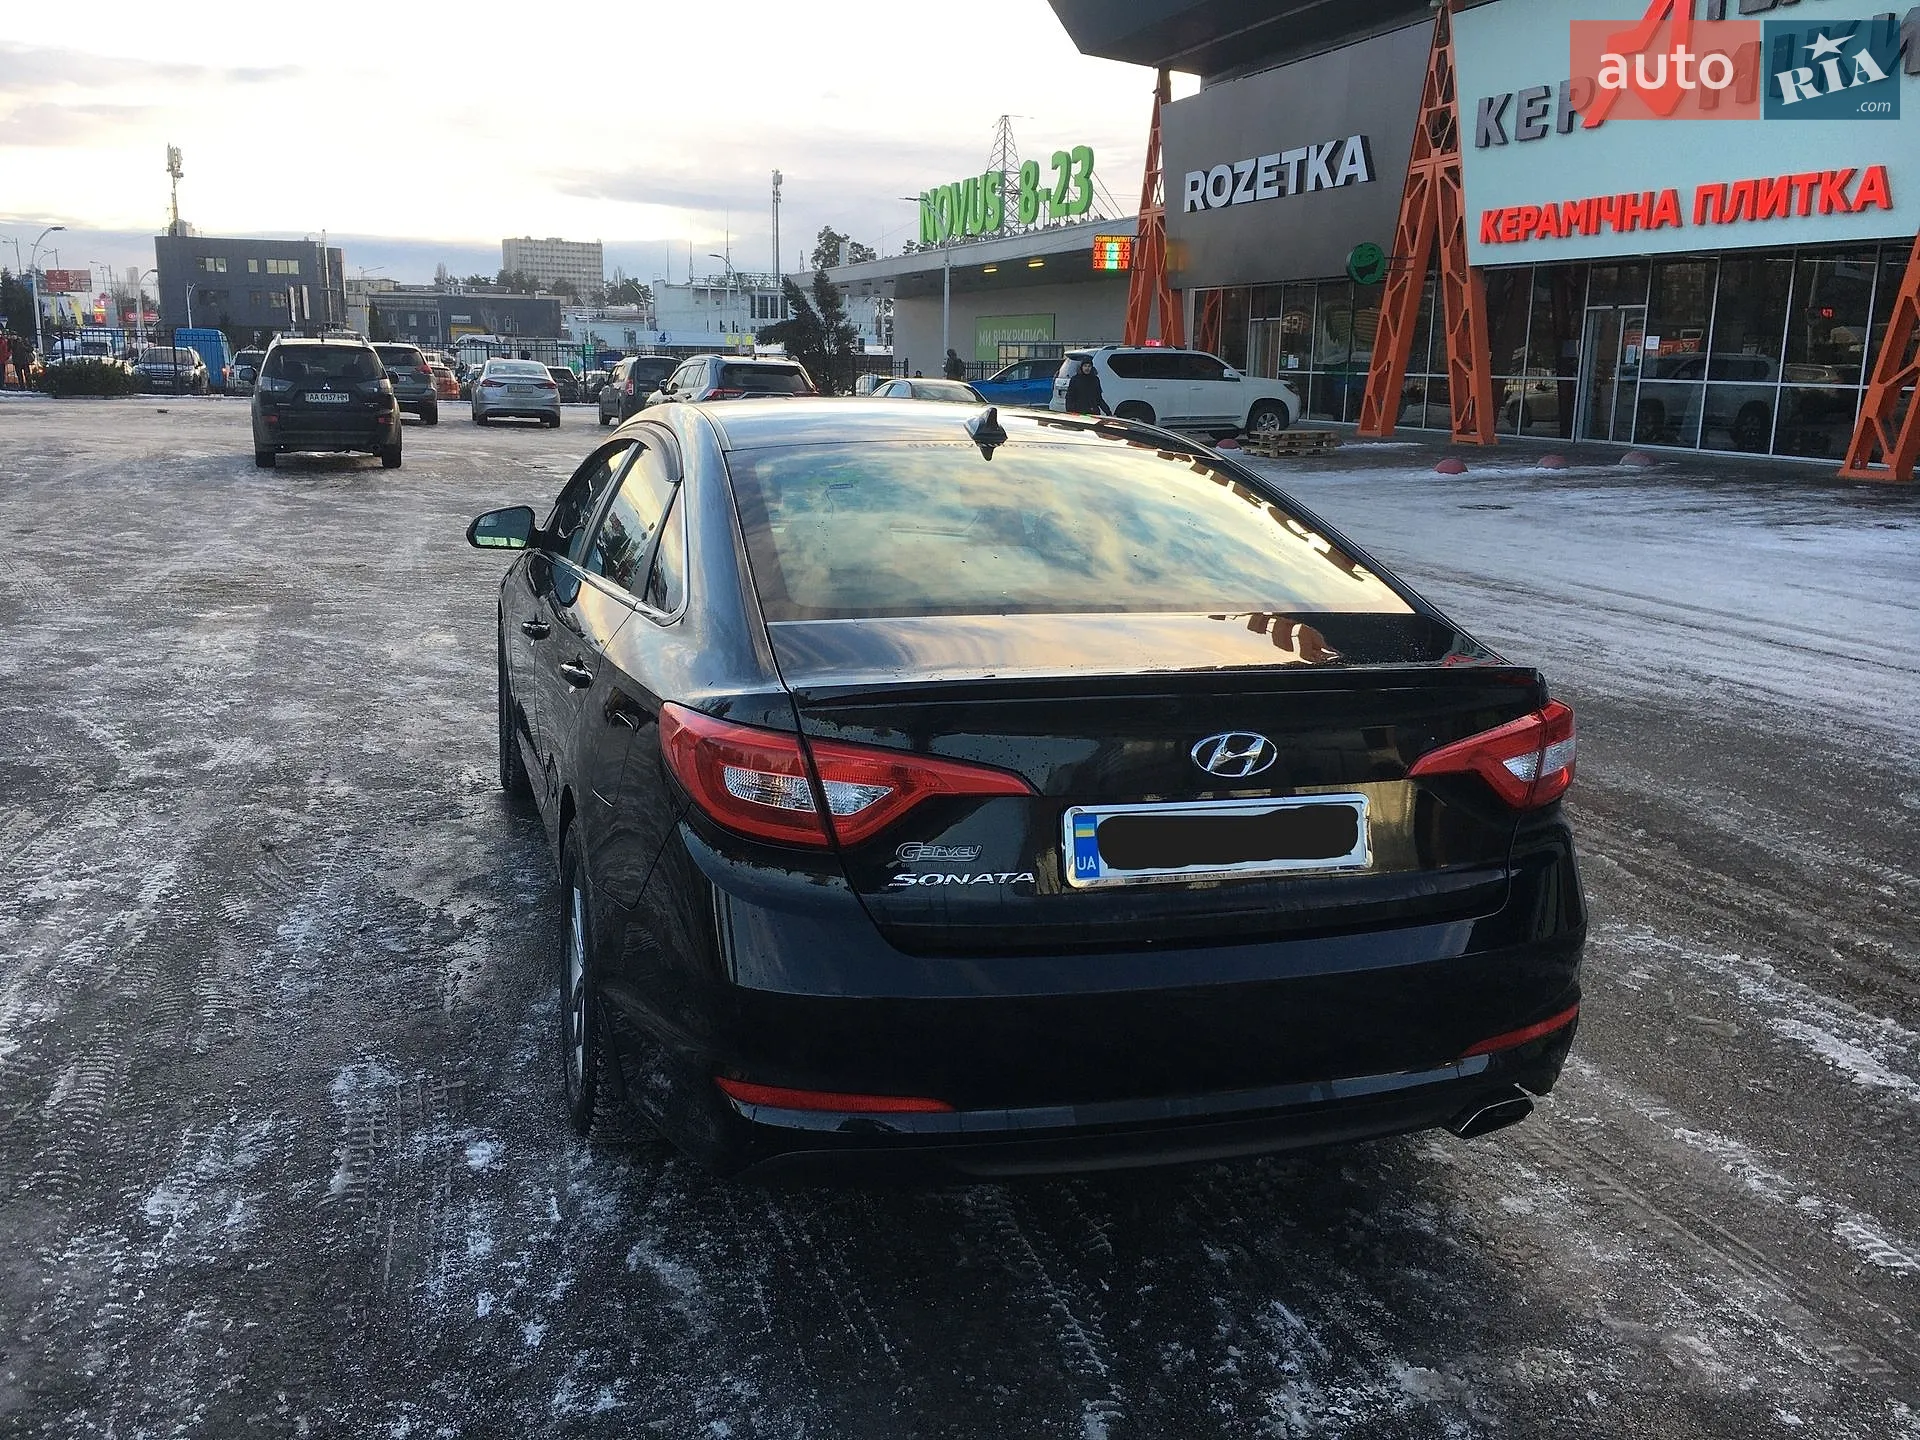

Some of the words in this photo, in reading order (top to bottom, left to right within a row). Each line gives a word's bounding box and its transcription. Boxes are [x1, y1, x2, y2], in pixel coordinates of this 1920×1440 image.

[1183, 134, 1375, 213] ROZETKA
[919, 170, 1005, 245] NOVUS
[1019, 145, 1095, 225] 8-23
[1479, 187, 1683, 244] КЕРАМІЧНА
[1692, 164, 1893, 225] ПЛИТКА
[977, 329, 992, 348] МИ
[895, 841, 983, 862] Garvey
[1076, 855, 1097, 870] UA
[888, 872, 1036, 887] SONATA
